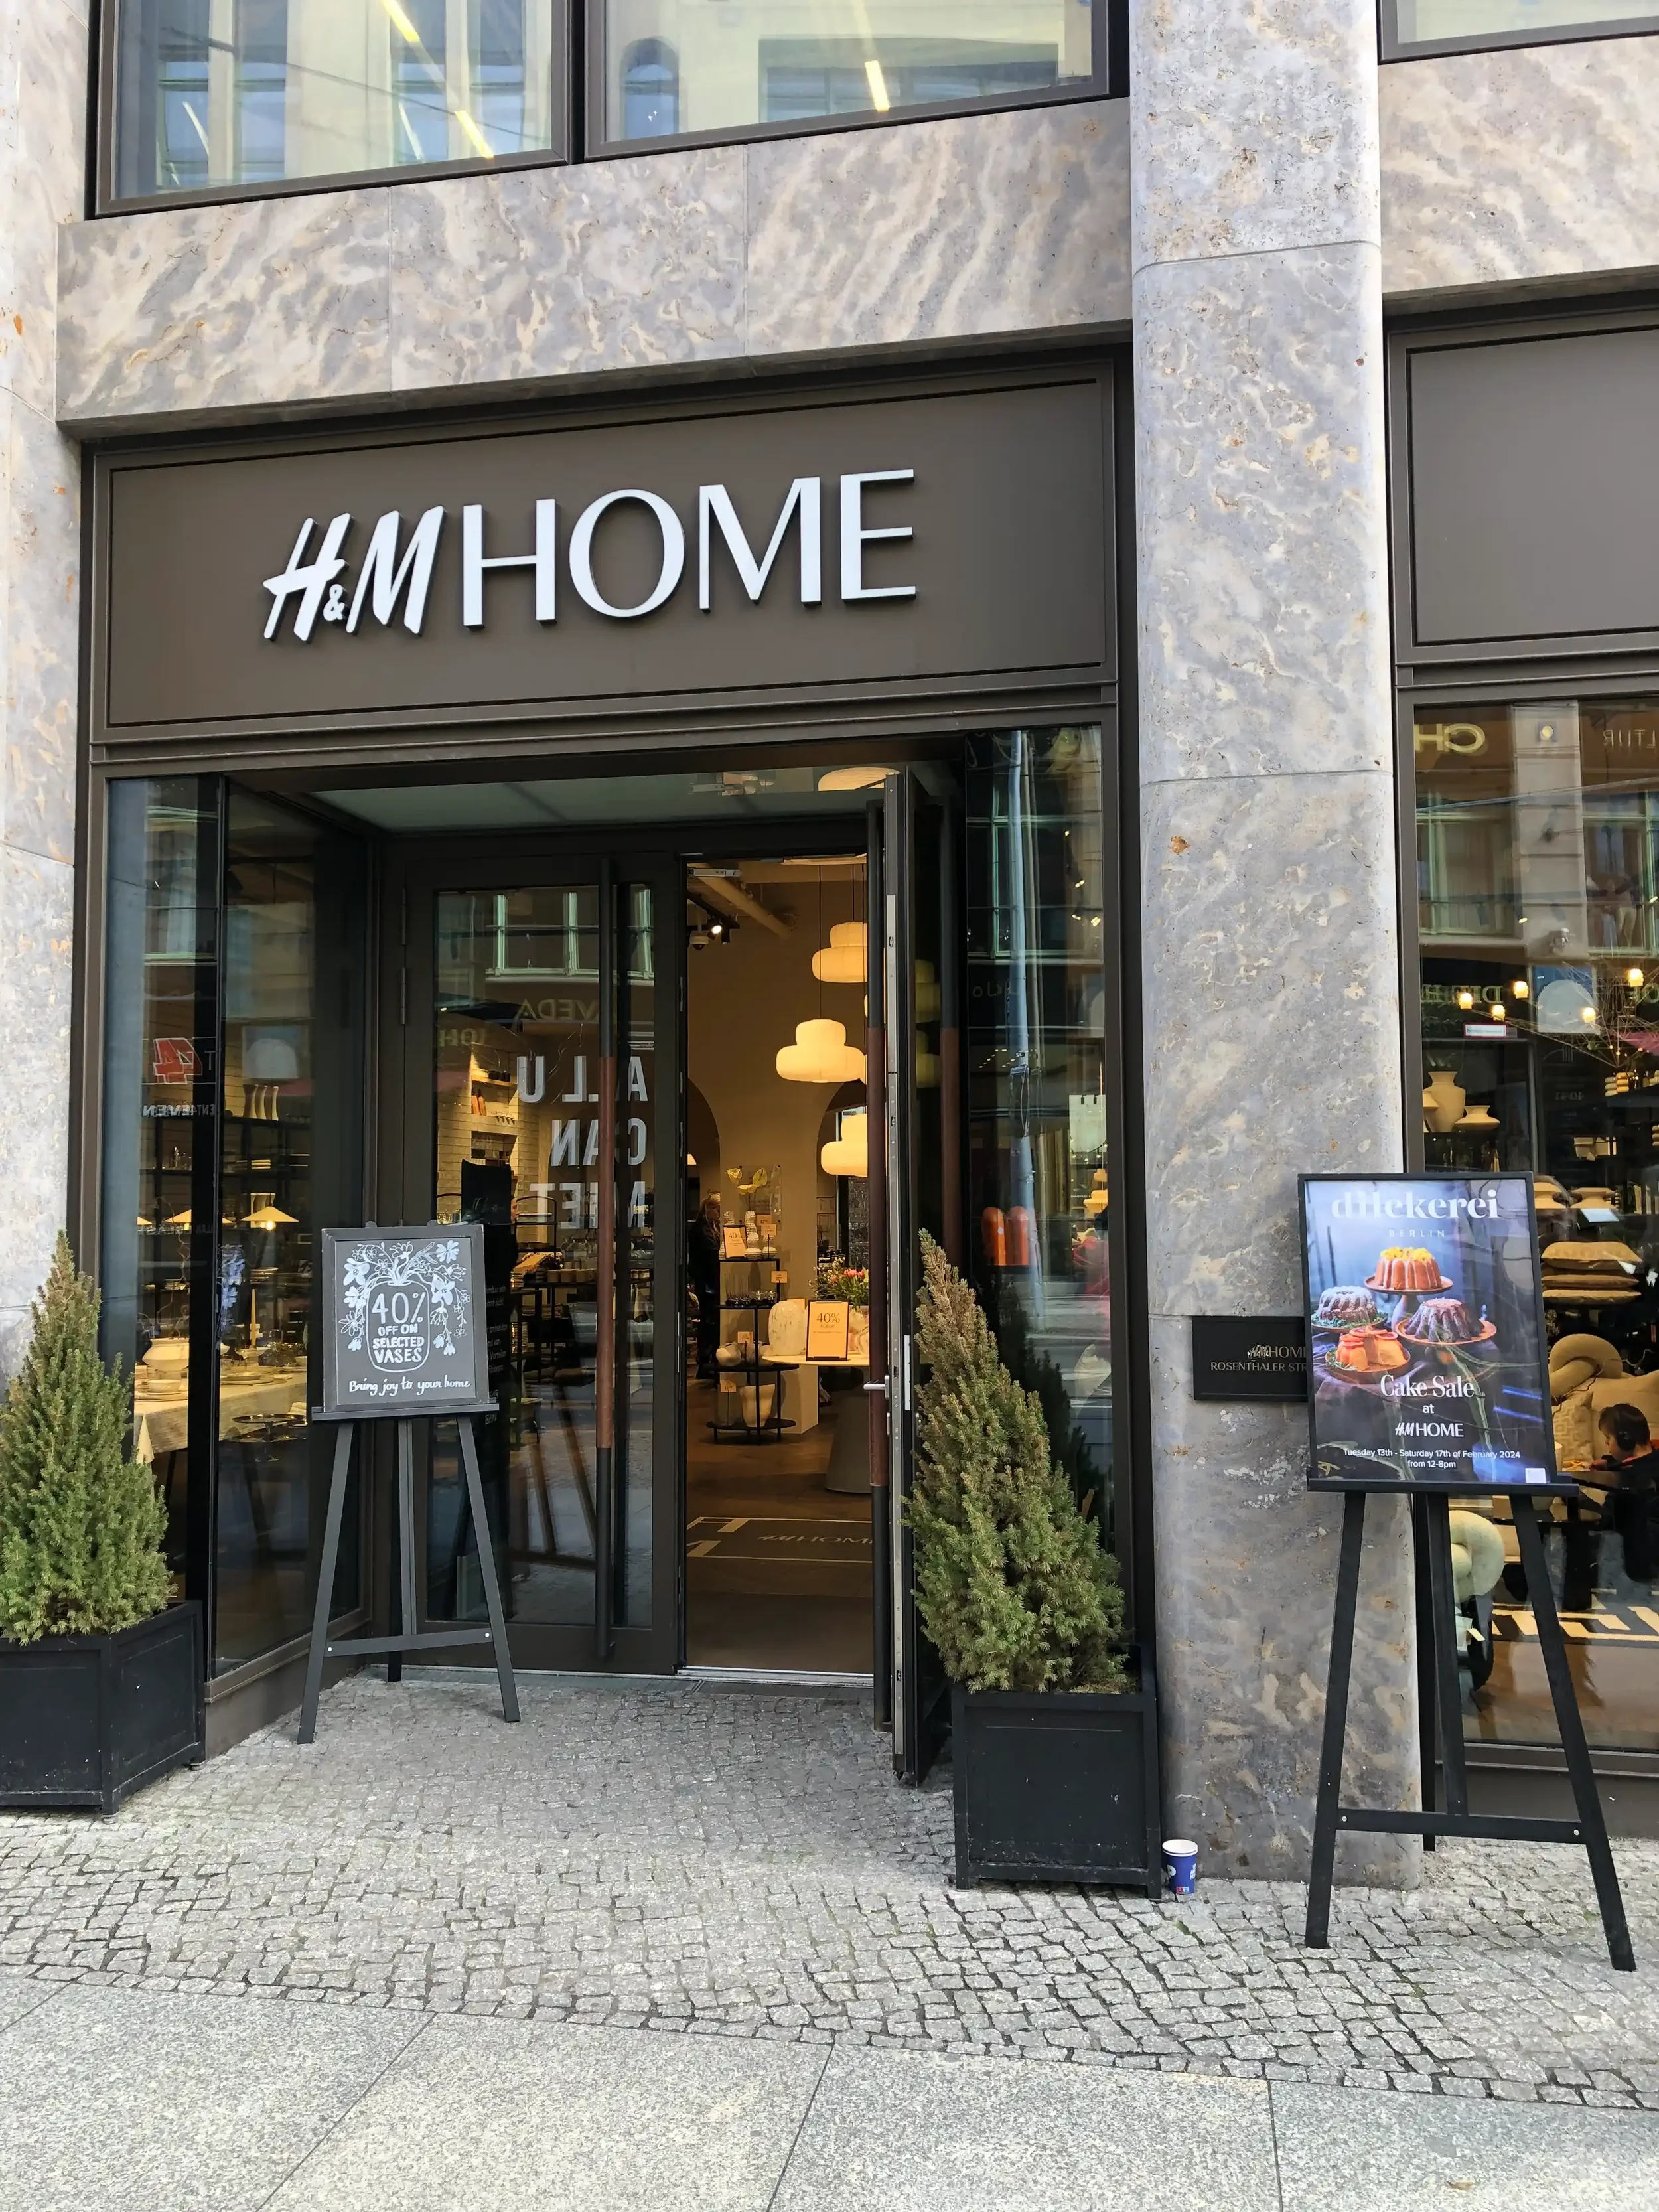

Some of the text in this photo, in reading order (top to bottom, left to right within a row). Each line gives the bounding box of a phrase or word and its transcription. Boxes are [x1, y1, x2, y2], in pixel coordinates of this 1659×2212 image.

[262, 468, 917, 642] H&M HOME
[1331, 1189, 1500, 1218] dilekerei
[1389, 1229, 1445, 1238] BERLIN
[371, 1292, 426, 1324] 40%
[816, 1313, 840, 1323] 40%
[378, 1323, 418, 1337] OFF ON
[372, 1336, 425, 1349] SELECTED
[374, 1347, 423, 1363] VASES
[1210, 1361, 1285, 1372] ROSENTHALER
[349, 1375, 470, 1396] Bring joy to your home
[1380, 1374, 1475, 1398] Cake Sale
[1422, 1403, 1435, 1414] at
[1415, 1422, 1464, 1437] HOME
[1343, 1448, 1376, 1457] Tuesday
[1399, 1449, 1434, 1459] Saturday
[1453, 1449, 1461, 1458] of
[1463, 1450, 1498, 1460] February
[1427, 1461, 1456, 1469] 12-8pm
[796, 1535, 873, 1544] HOM
